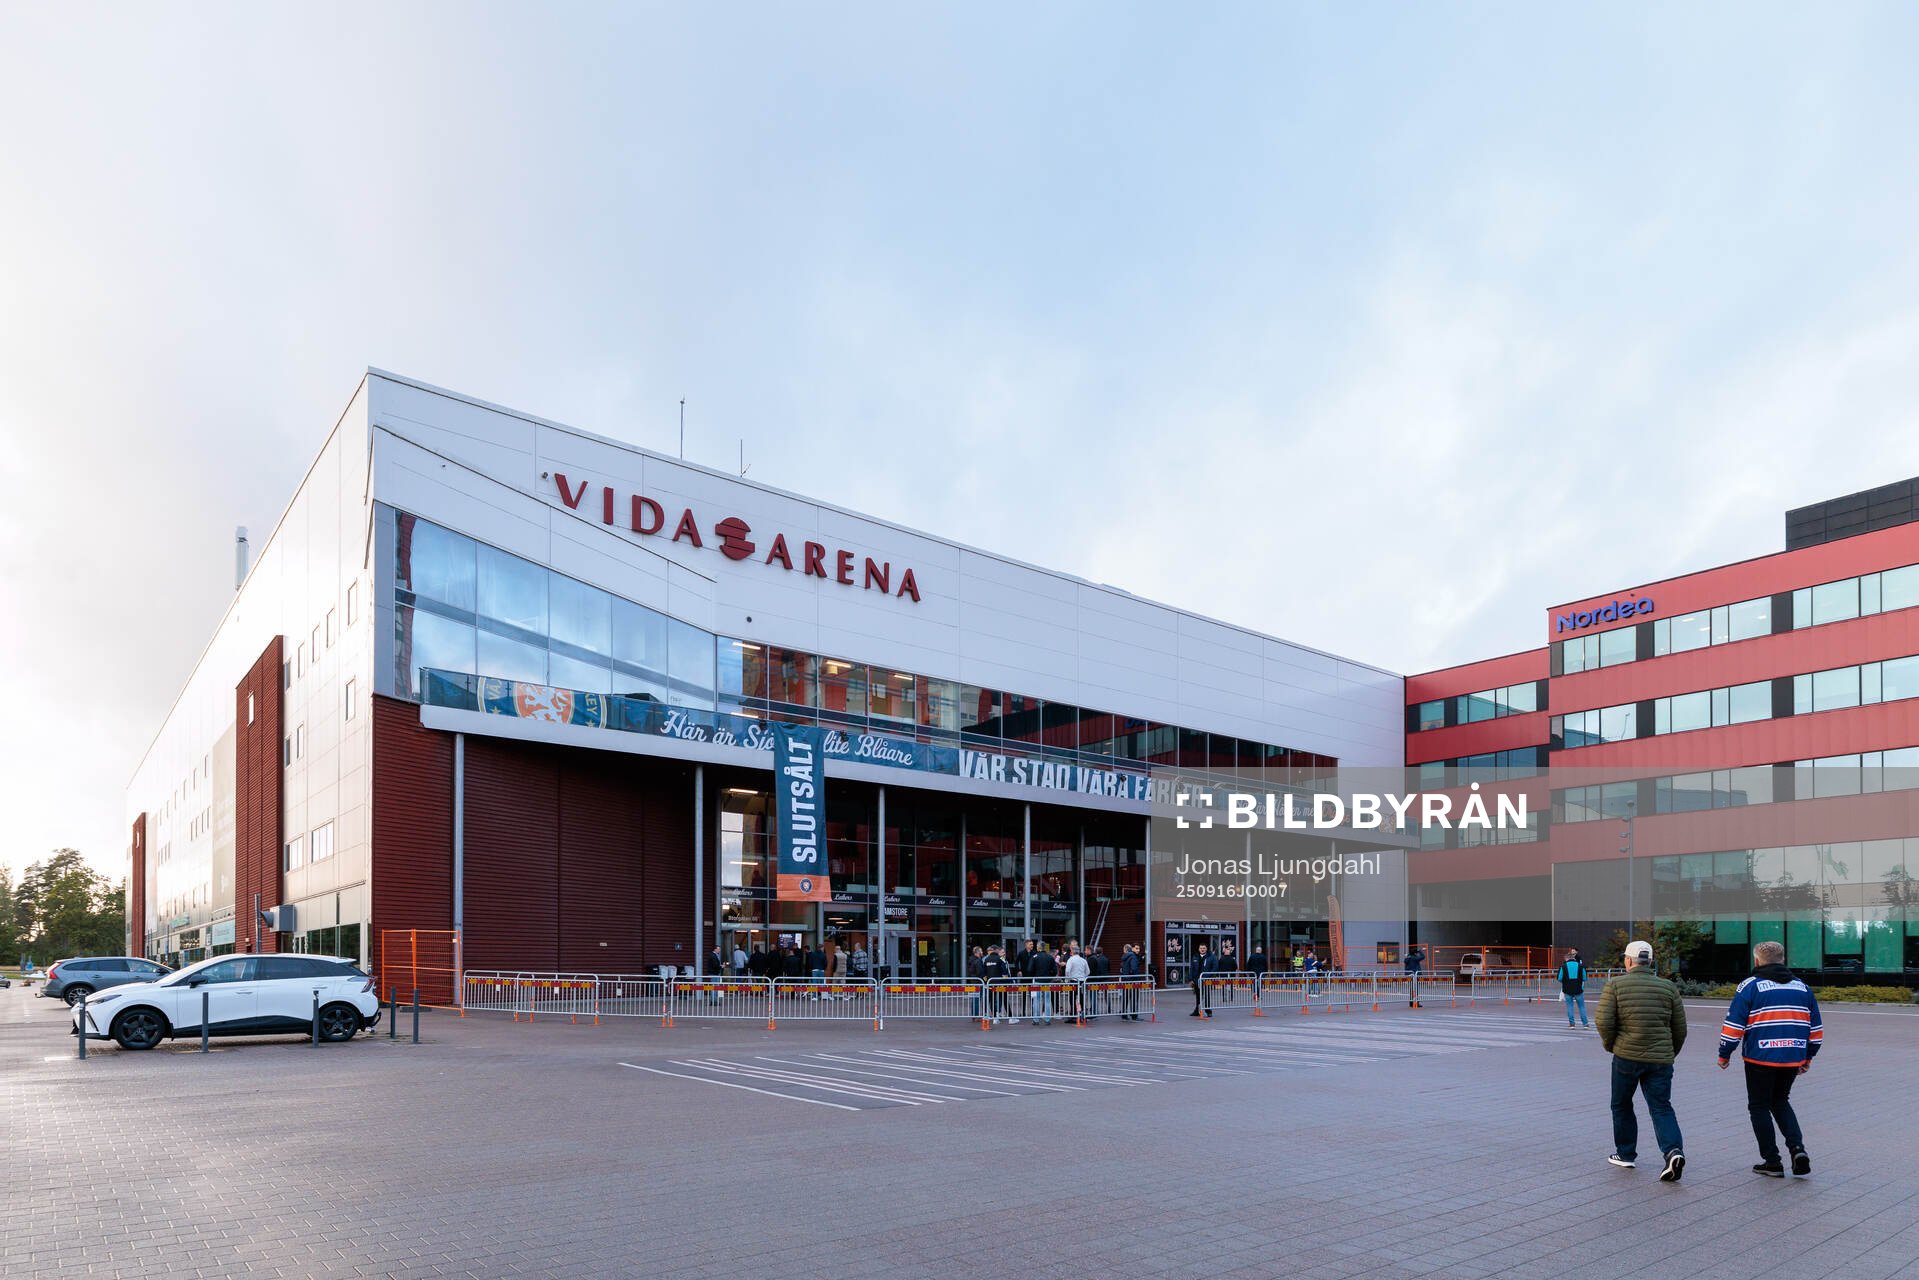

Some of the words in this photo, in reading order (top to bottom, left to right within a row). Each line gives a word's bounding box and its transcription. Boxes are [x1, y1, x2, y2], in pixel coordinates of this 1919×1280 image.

[554, 473, 703, 547] VIDA
[766, 533, 921, 603] ARENA
[1556, 597, 1654, 633] Nordea
[660, 709, 706, 743] Här
[712, 727, 737, 747] är
[743, 724, 775, 752] Sjö
[855, 734, 914, 766] Blåare
[784, 737, 817, 863] SLUTSÅLT
[958, 749, 1006, 784] VÅR
[1012, 758, 1071, 792] STAD
[1076, 766, 1129, 799] VÅRA
[878, 907, 908, 916] AMSTORE
